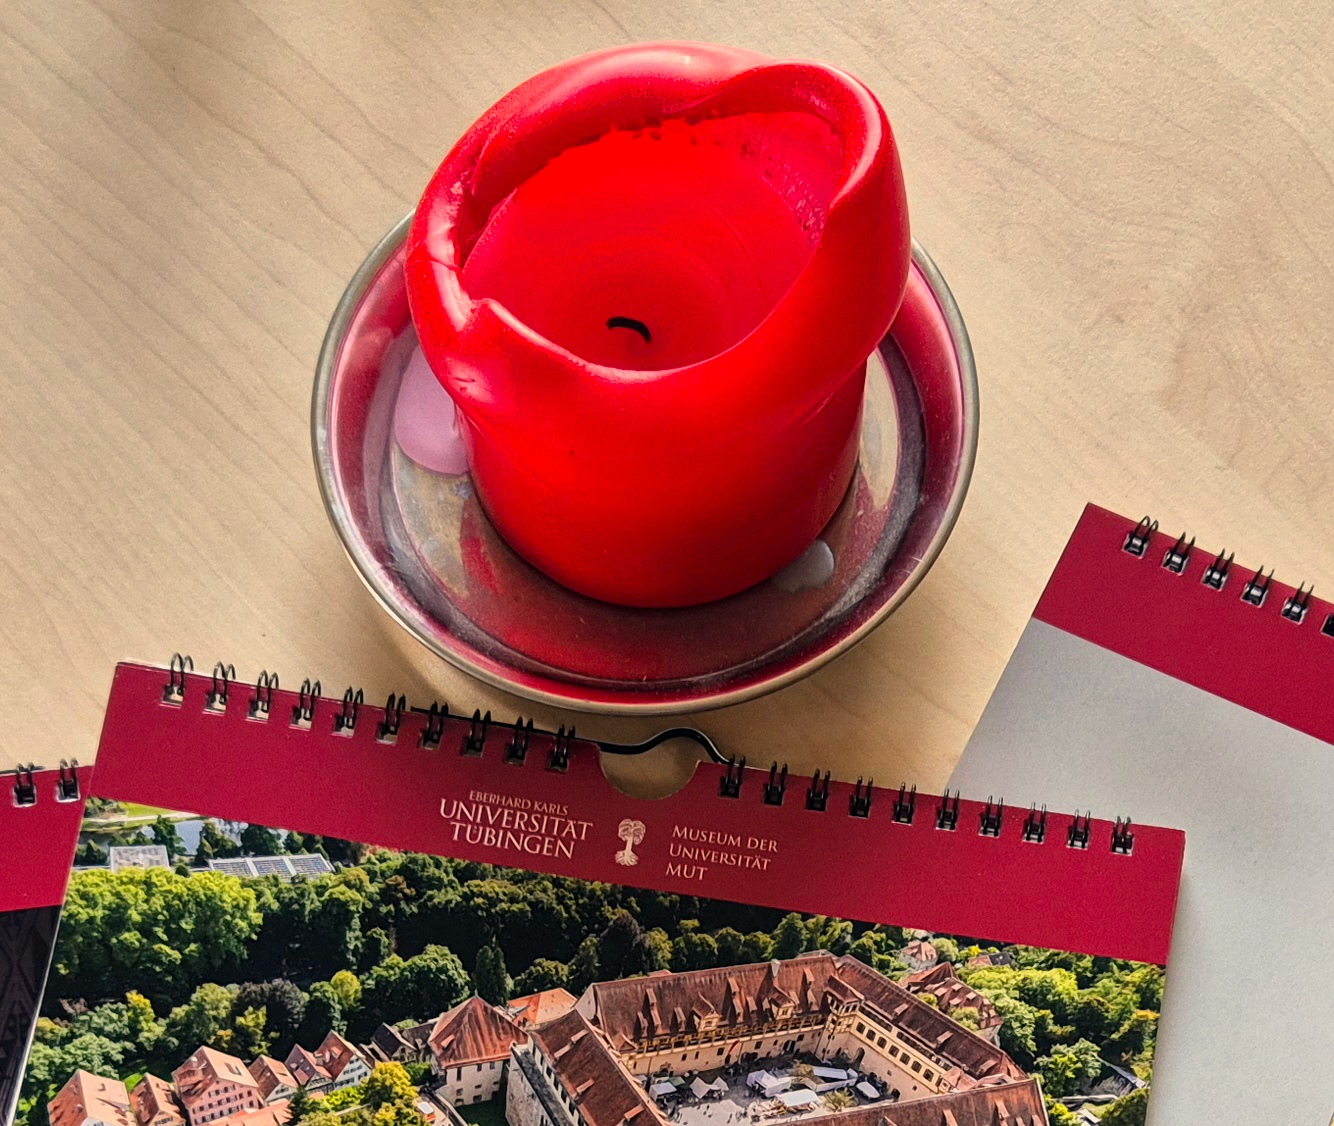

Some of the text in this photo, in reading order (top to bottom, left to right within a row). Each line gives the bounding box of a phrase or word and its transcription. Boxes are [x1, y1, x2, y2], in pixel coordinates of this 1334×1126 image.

[469, 790, 569, 816] EBERHARD KARLS
[439, 798, 594, 840] UNIVERSITÄT
[450, 821, 575, 860] TÜBINGEN
[671, 825, 778, 853] MUSEUM DER
[669, 843, 771, 872] UNIVERSITÄT
[666, 863, 708, 881] MUT
